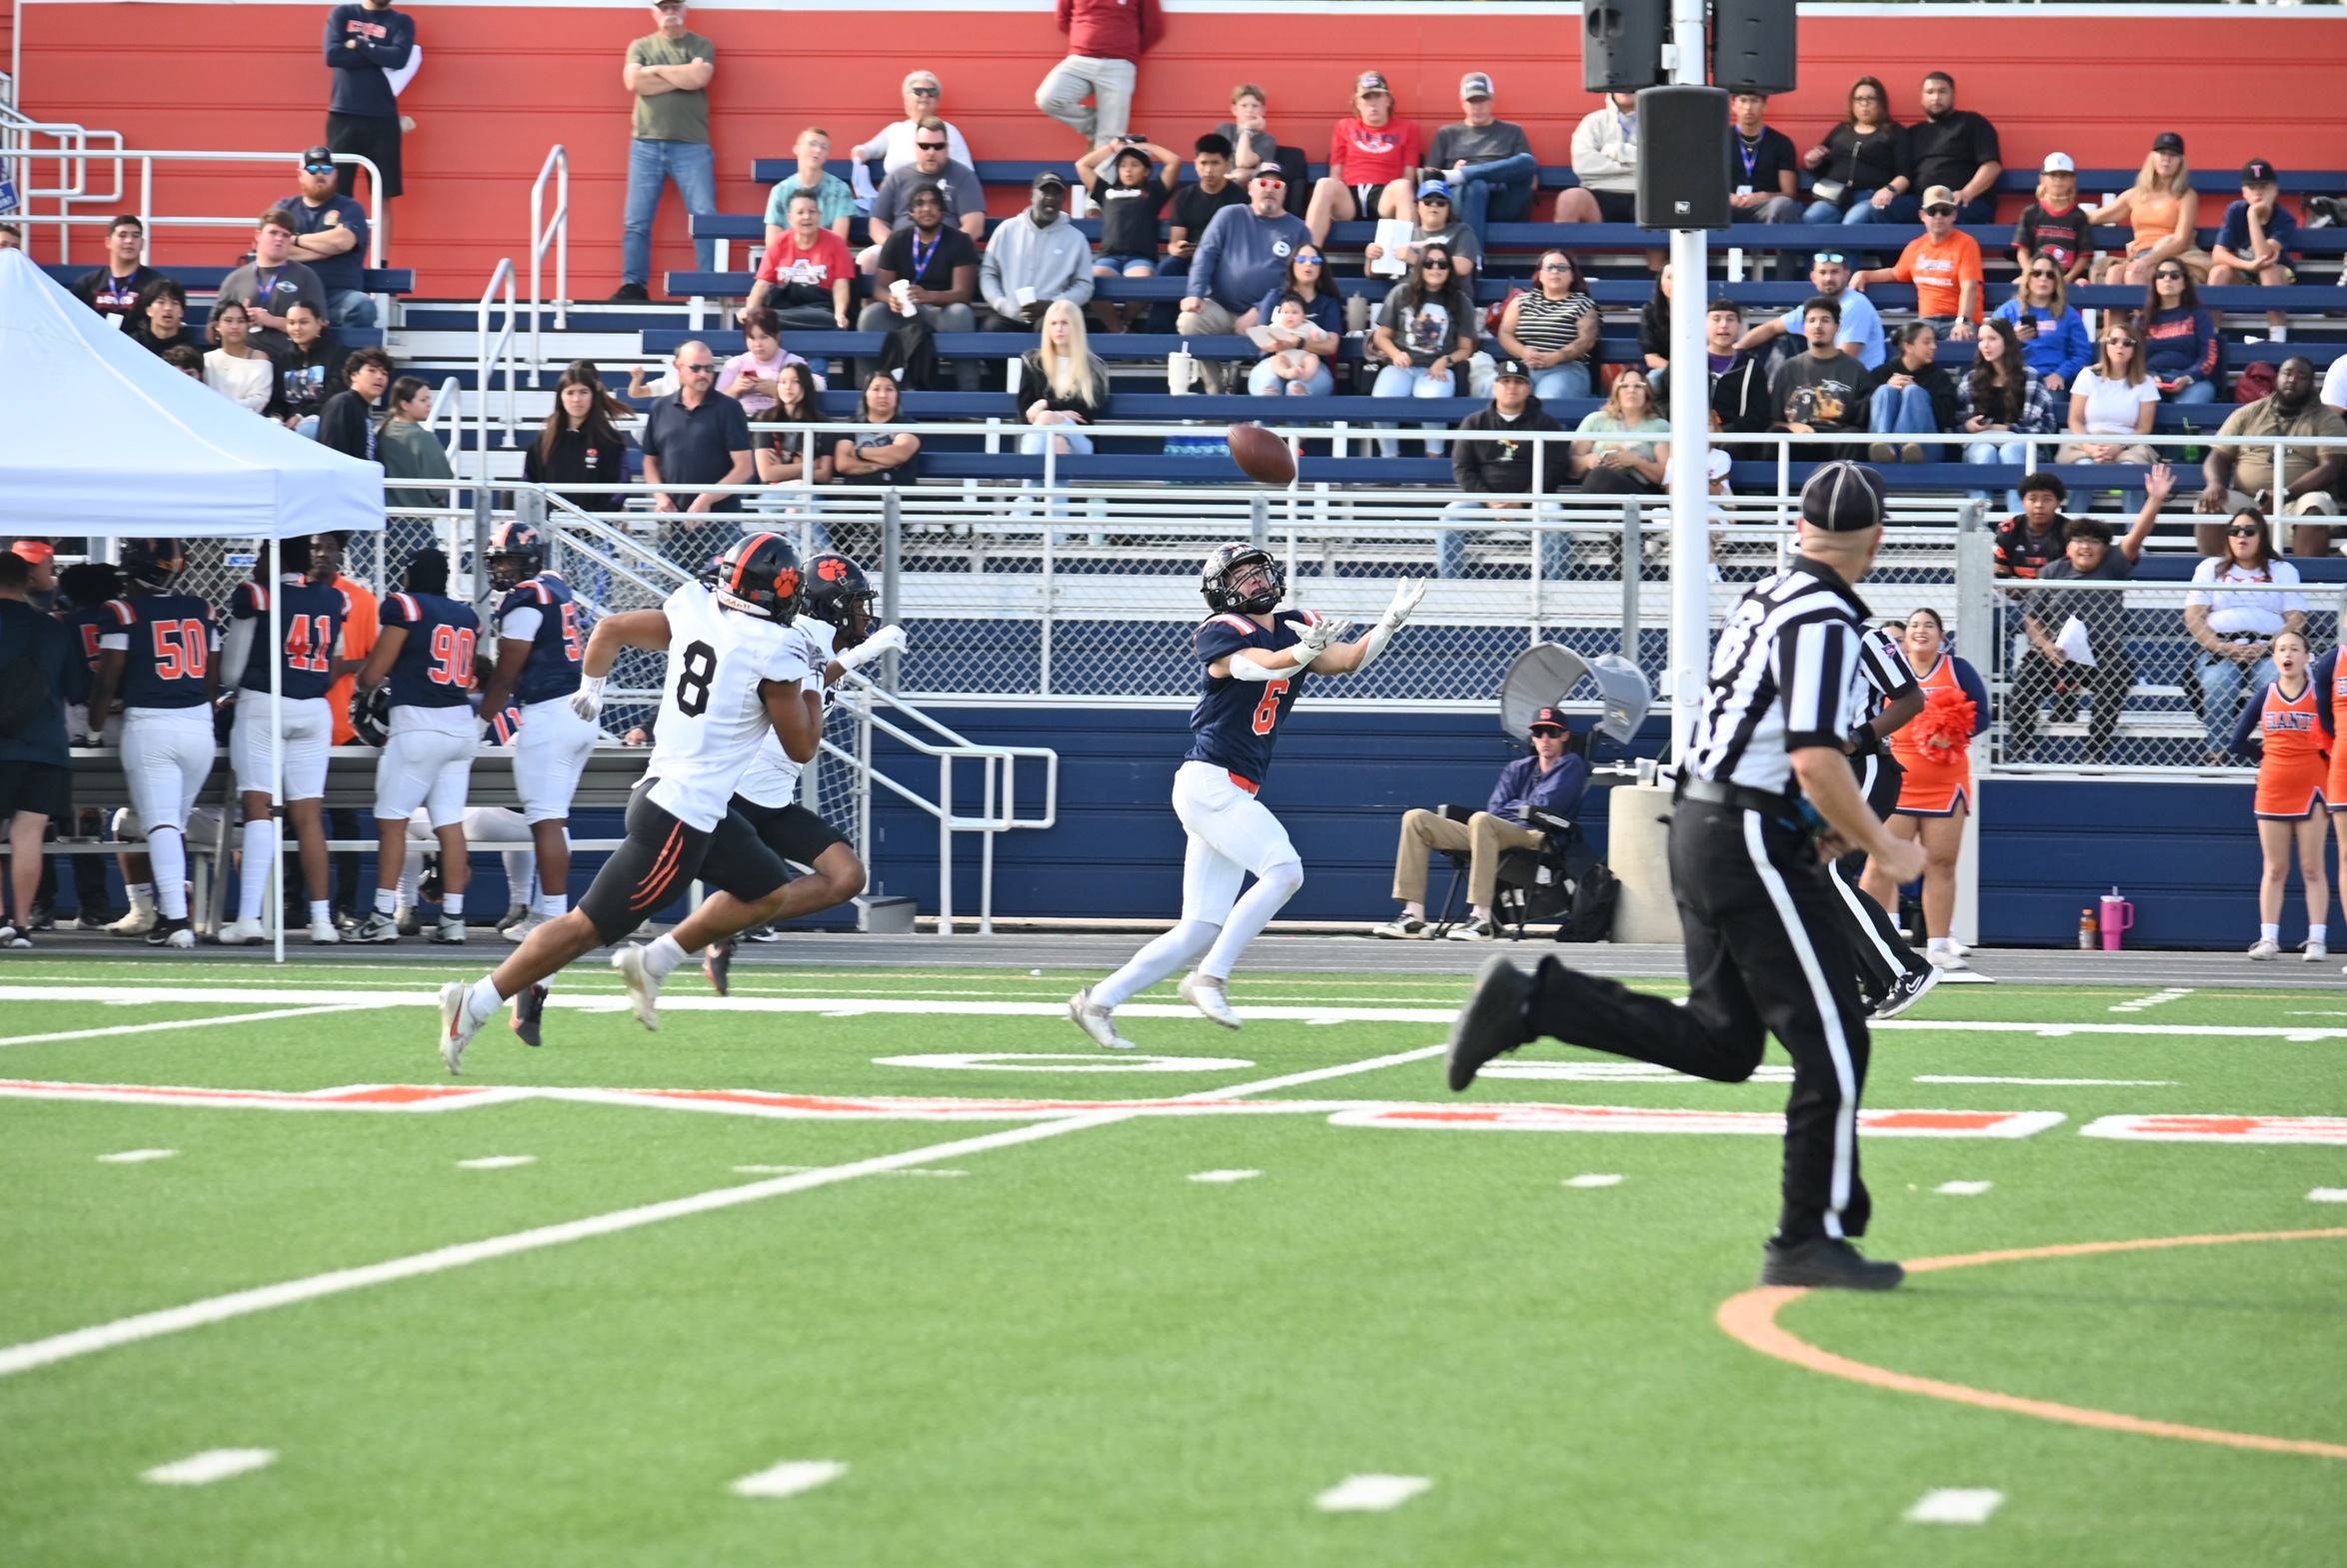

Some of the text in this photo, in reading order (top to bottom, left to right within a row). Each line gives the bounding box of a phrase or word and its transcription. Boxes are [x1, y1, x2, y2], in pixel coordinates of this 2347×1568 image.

[151, 619, 208, 680] 50
[283, 614, 331, 672] 41
[427, 624, 476, 688] 90
[677, 640, 717, 718] 8
[1251, 679, 1289, 736] 6
[2264, 711, 2317, 732] GIANT
